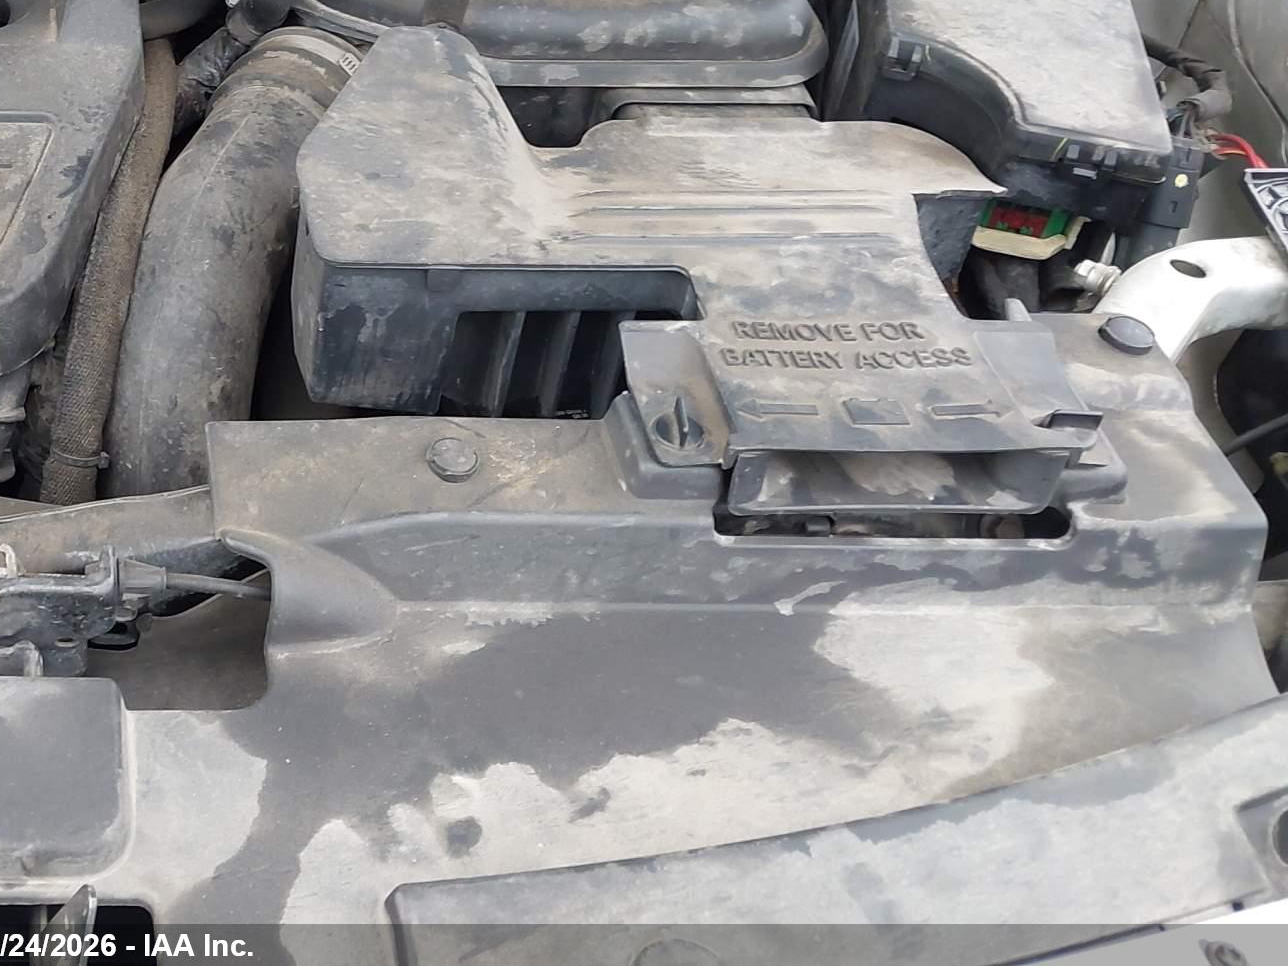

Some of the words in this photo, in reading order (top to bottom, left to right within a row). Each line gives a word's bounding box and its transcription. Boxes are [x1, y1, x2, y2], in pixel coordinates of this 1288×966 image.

[731, 320, 857, 342] REMOVE
[859, 320, 926, 342] FOR
[720, 347, 844, 370] BATTERY
[854, 345, 973, 370] ACCESS
